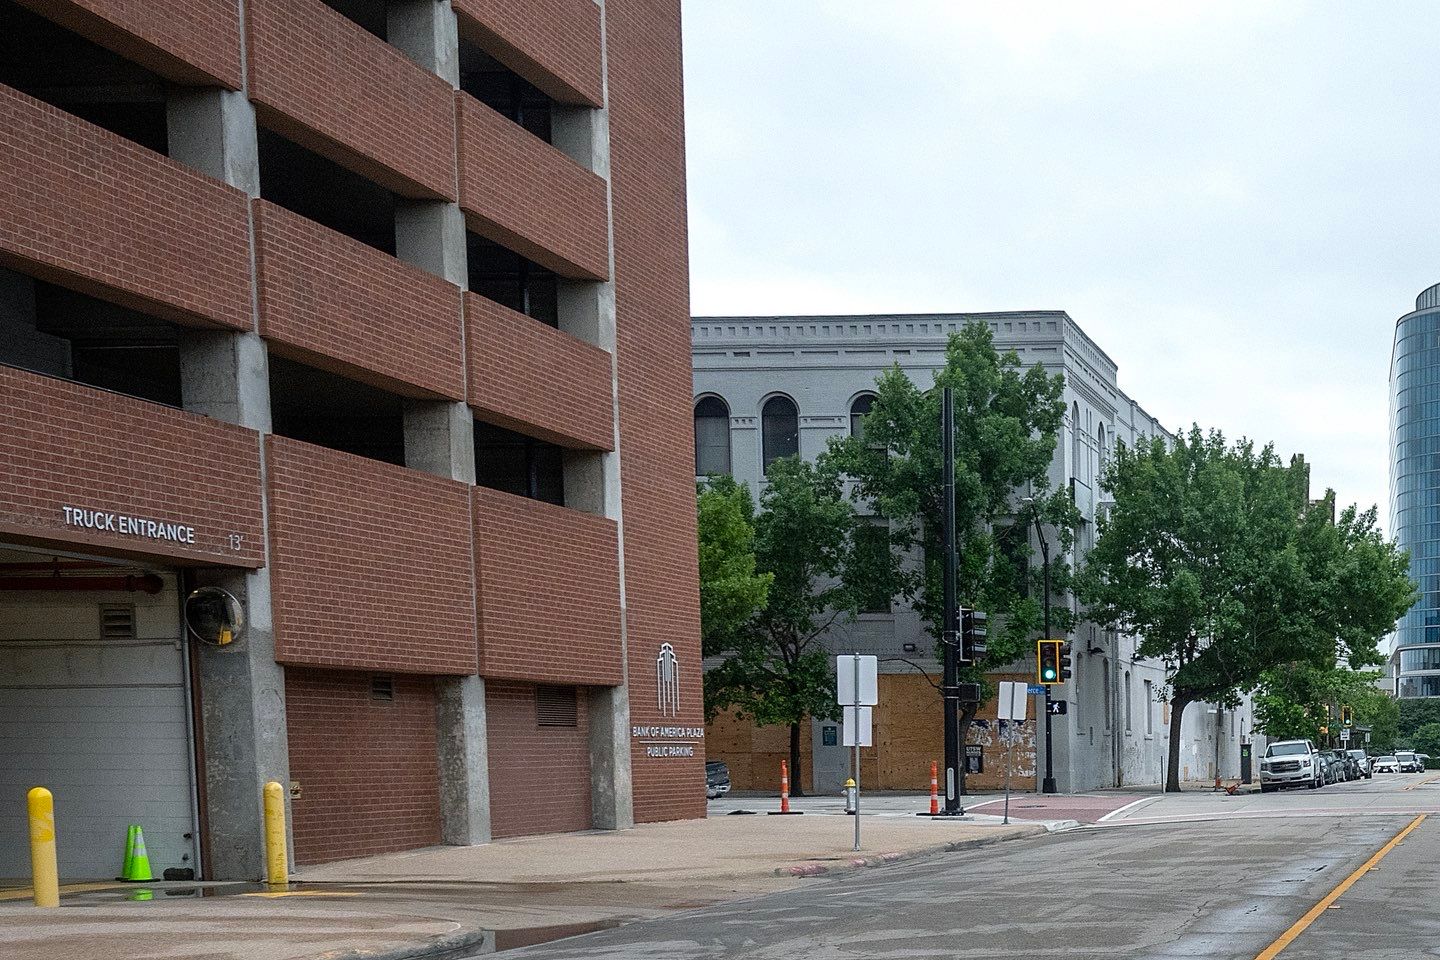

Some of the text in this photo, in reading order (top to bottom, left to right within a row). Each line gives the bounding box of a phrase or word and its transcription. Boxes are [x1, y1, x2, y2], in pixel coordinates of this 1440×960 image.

[63, 506, 196, 544] TRUCK ENTRANCE
[632, 726, 705, 738] BANK OF AMERICA PLAZA
[647, 746, 694, 757] PUBLIC PARKING
